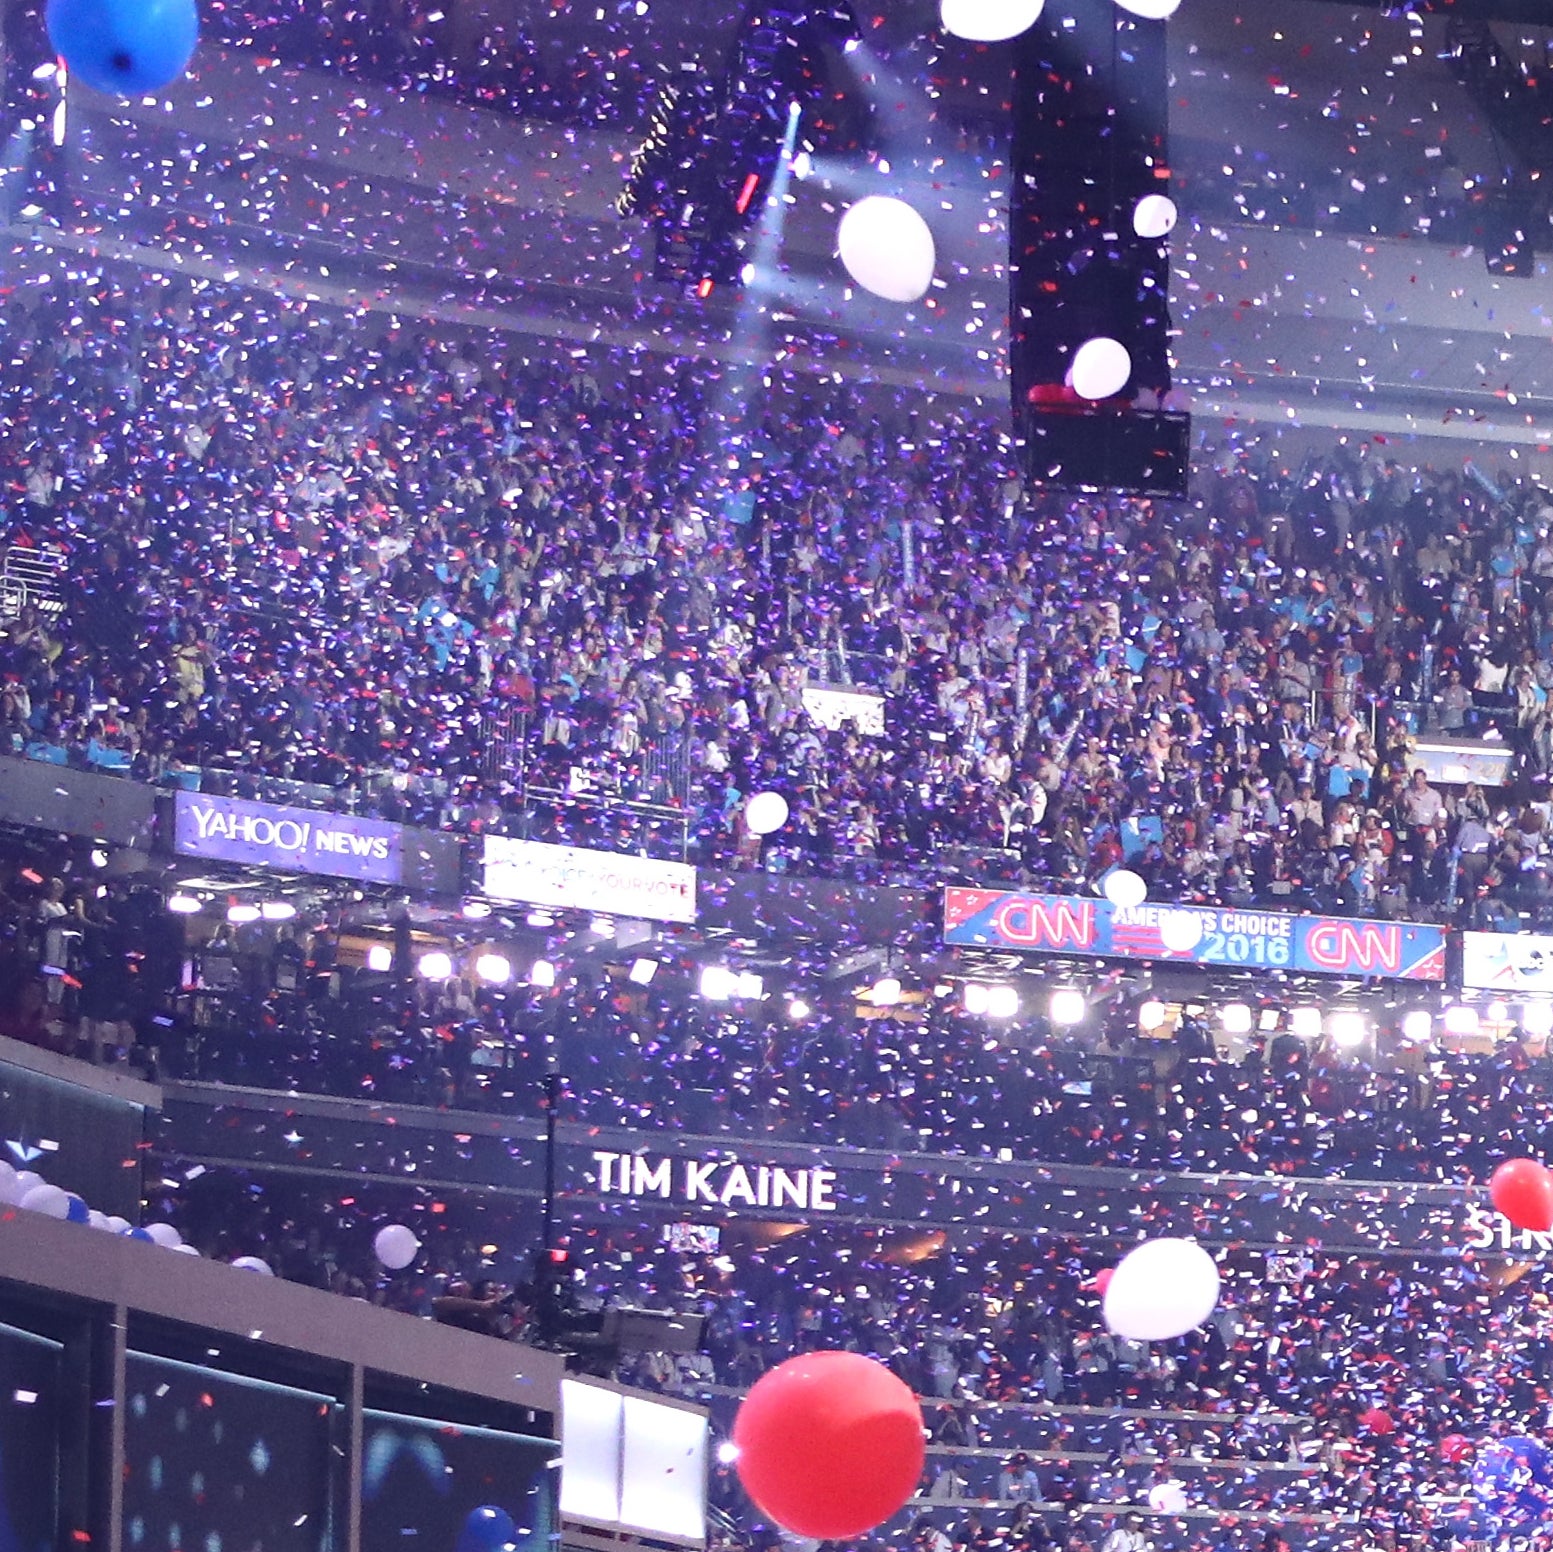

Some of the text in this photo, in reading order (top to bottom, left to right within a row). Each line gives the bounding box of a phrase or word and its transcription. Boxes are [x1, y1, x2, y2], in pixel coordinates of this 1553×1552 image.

[191, 804, 389, 860] YAHOO! NEWS
[998, 903, 1094, 946] CNN
[1111, 905, 1291, 937] AMERA'S CHOICE
[1202, 932, 1290, 965] 2016
[1307, 926, 1398, 969] CNN
[593, 1150, 837, 1211] TIM KAINE
